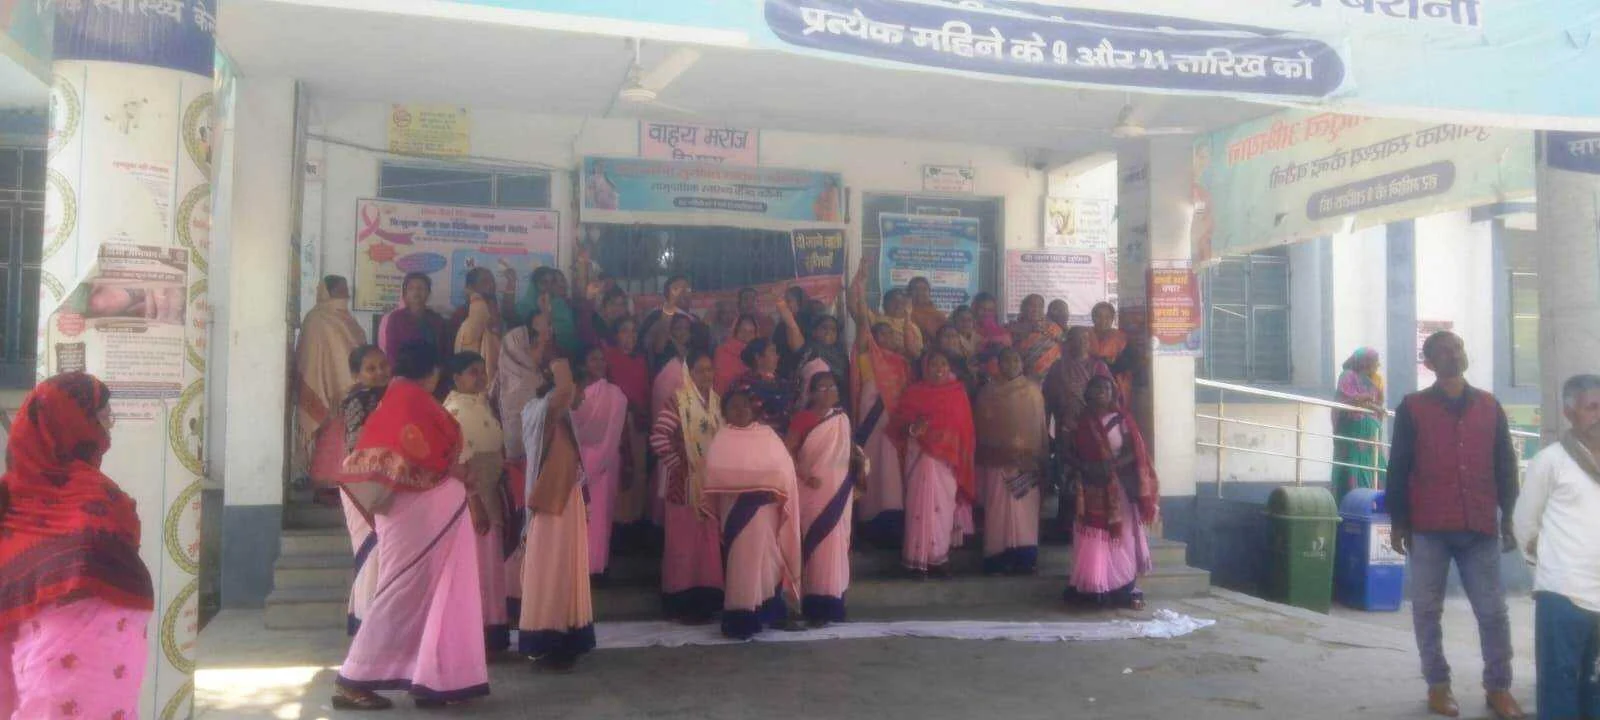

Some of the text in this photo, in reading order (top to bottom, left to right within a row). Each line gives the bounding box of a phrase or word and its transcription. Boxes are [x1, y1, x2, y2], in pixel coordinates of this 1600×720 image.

[800, 6, 905, 44] प्रत्येक
[910, 19, 1006, 59] महिने
[1010, 31, 1047, 64] के
[1076, 38, 1135, 69] और
[1271, 49, 1314, 81] को
